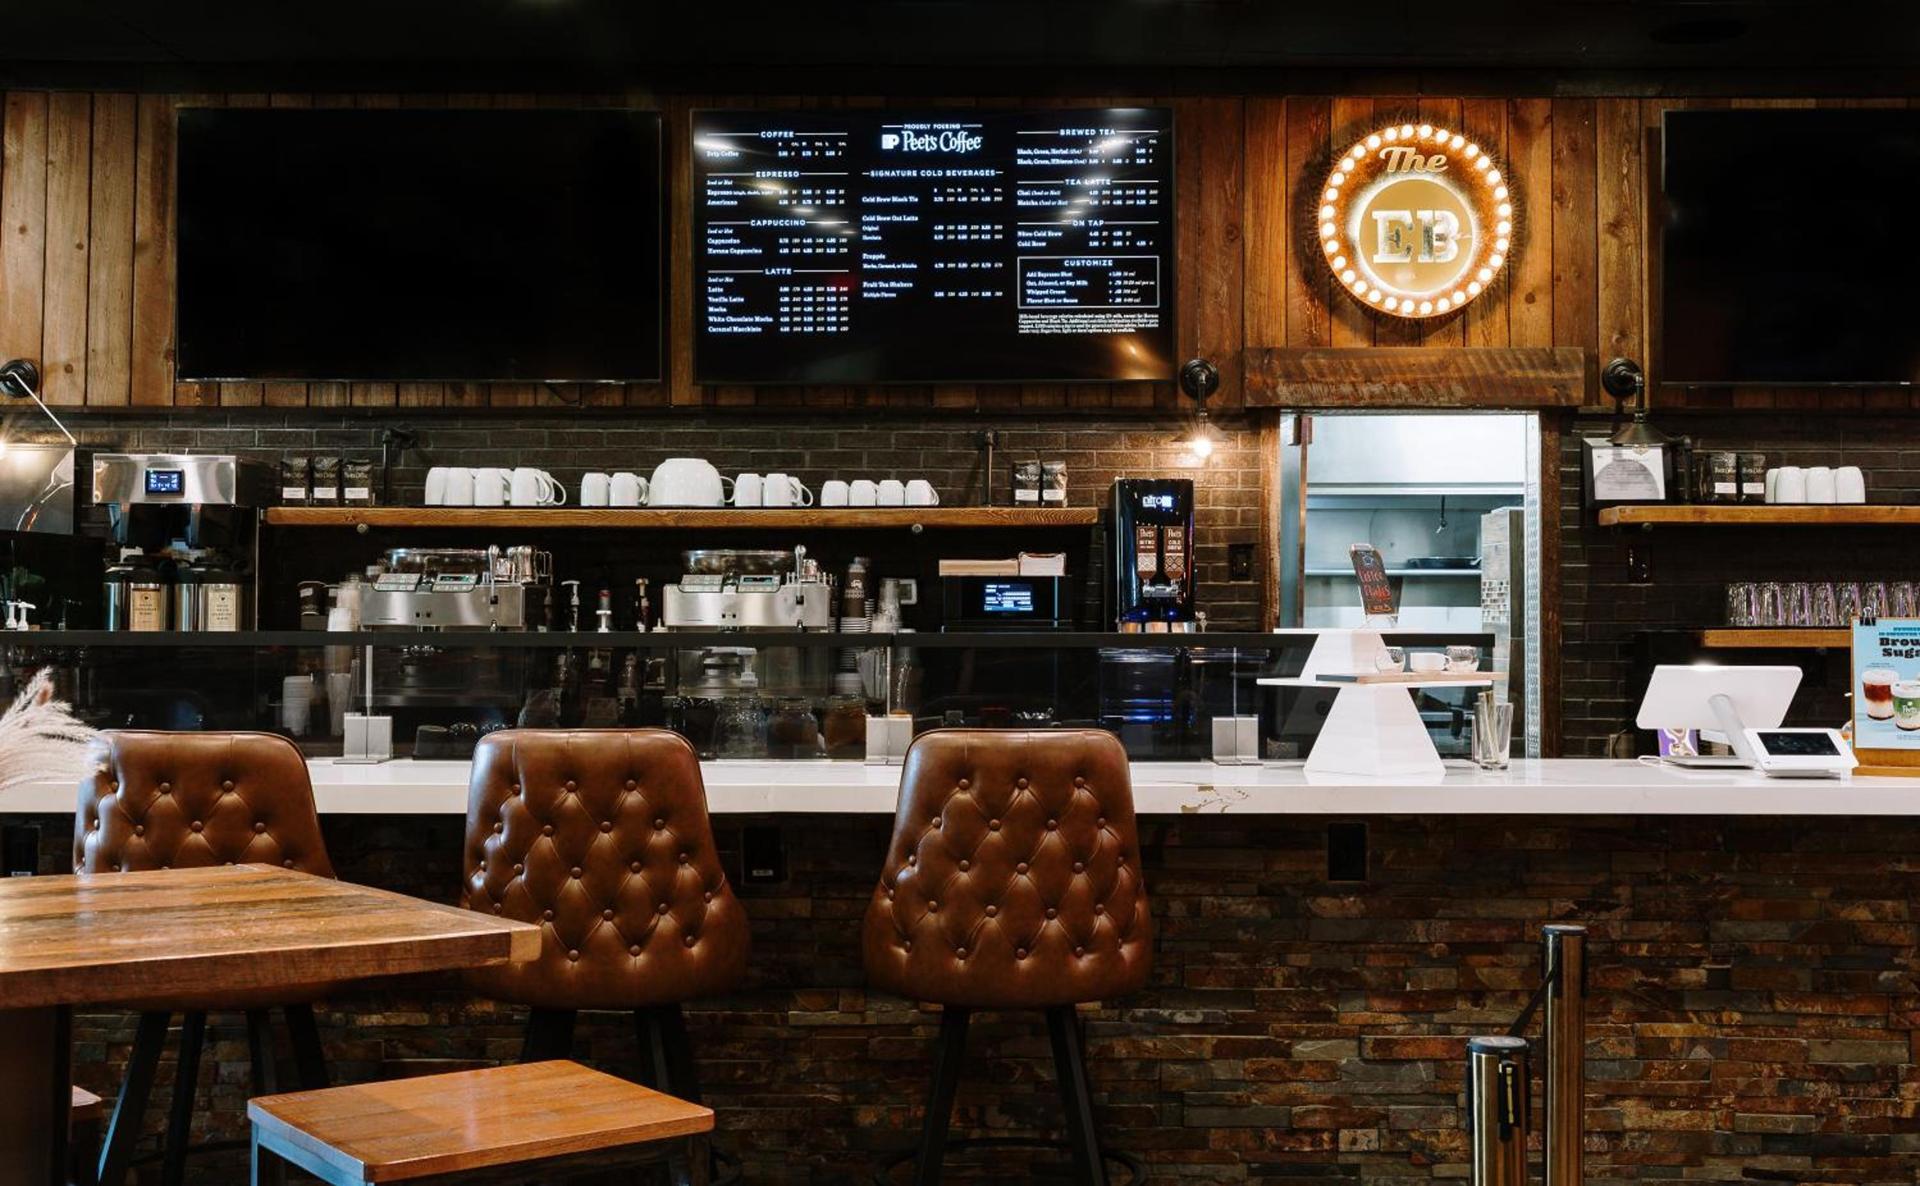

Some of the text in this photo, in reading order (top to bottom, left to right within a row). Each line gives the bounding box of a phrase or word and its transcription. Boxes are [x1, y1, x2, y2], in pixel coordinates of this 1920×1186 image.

[940, 131, 982, 153] Coffee
[1379, 146, 1449, 173] The
[1372, 210, 1460, 264] EB
